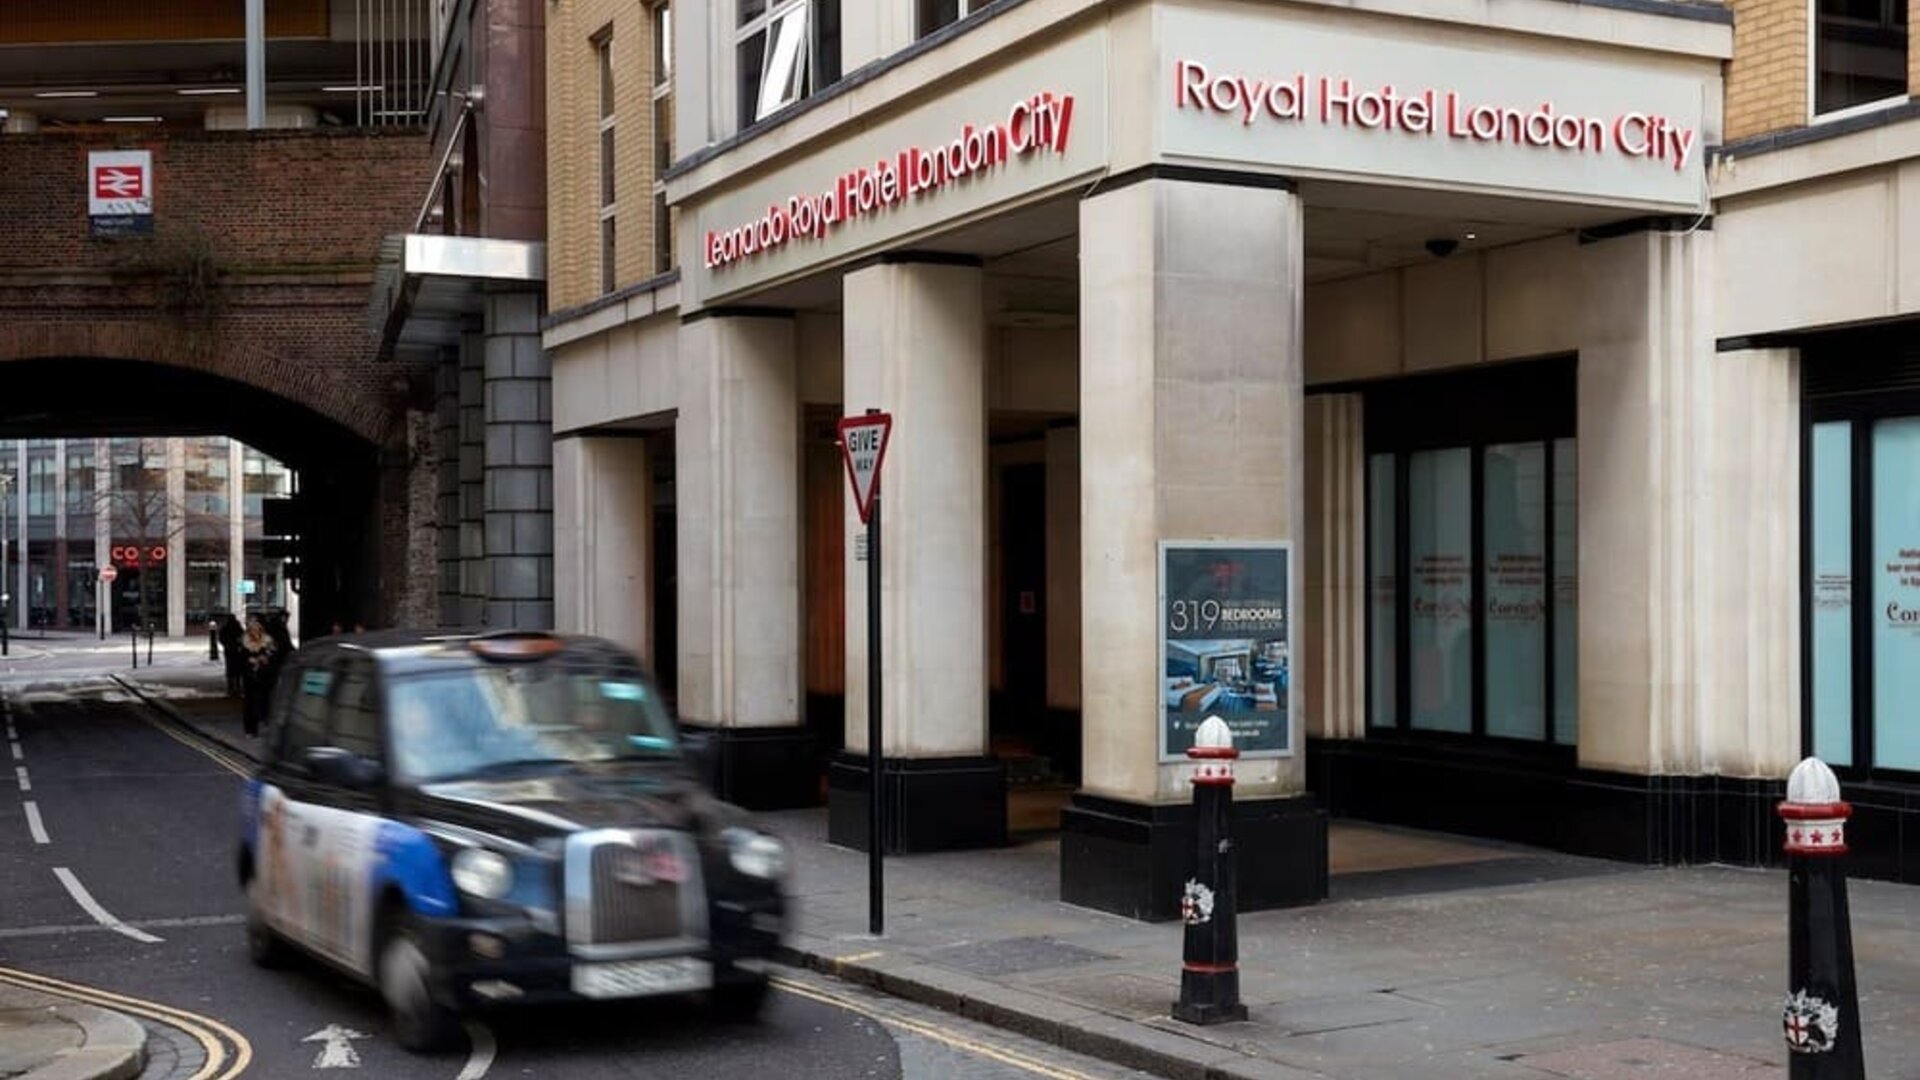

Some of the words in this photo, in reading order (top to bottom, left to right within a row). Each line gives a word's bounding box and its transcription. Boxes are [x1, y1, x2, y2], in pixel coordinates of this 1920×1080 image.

[1174, 60, 1308, 126] Royal
[1320, 78, 1437, 134] Hotel
[1446, 92, 1606, 153] London
[1613, 112, 1695, 170] City
[705, 206, 787, 269] Leonardo
[788, 178, 846, 238] Royal
[846, 152, 906, 217] Hotel
[908, 126, 1006, 193] London
[1008, 92, 1074, 153] City
[849, 430, 878, 452] GIVE
[1170, 600, 1220, 631] 319
[1222, 608, 1282, 620] BEDROOMS
